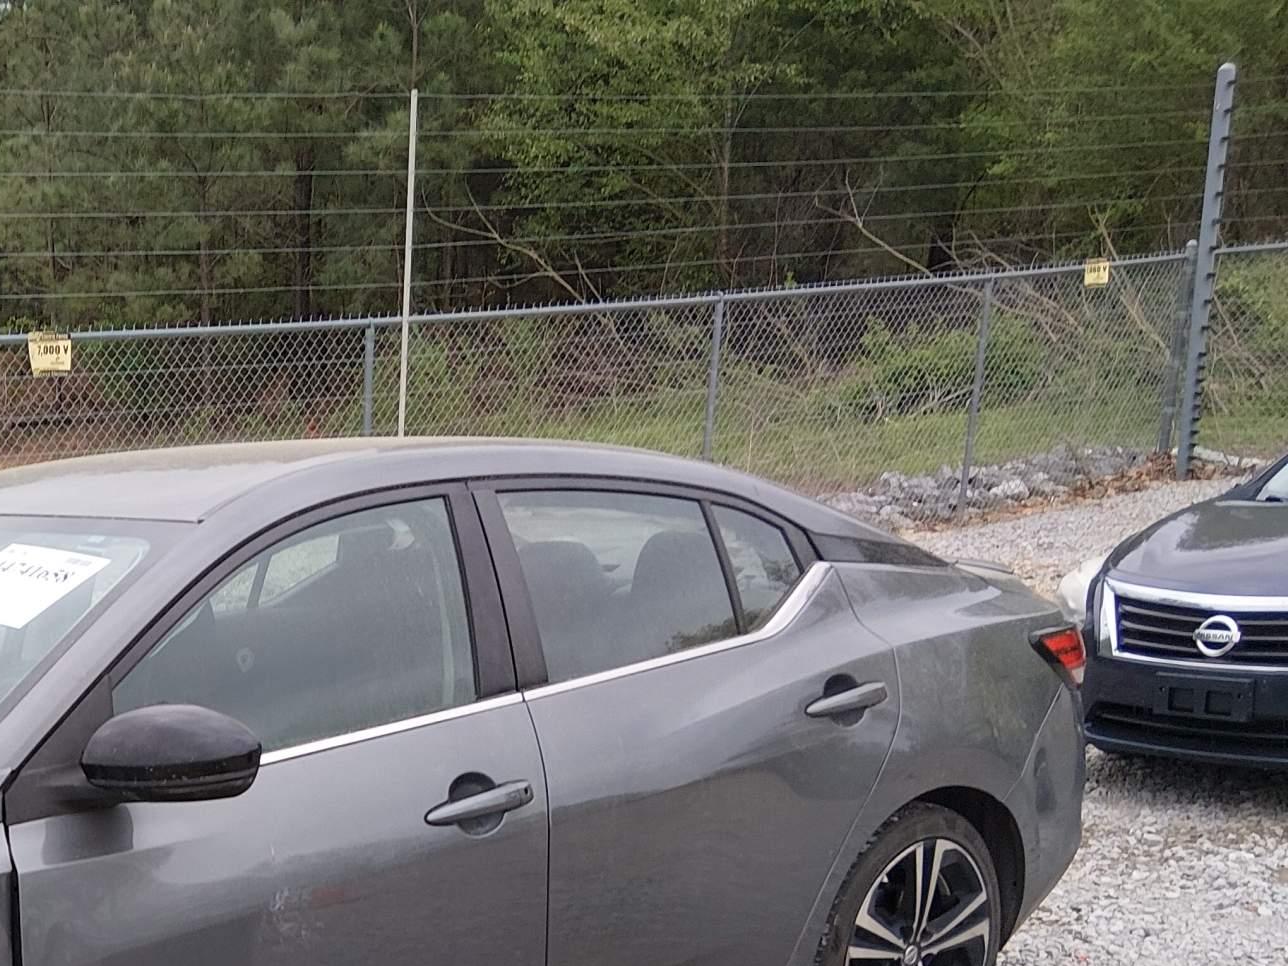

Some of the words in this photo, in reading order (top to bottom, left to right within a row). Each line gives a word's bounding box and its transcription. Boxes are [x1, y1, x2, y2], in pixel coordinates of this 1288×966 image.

[37, 344, 61, 357] 7,000
[63, 344, 69, 355] V
[1196, 631, 1234, 641] NISSAN
